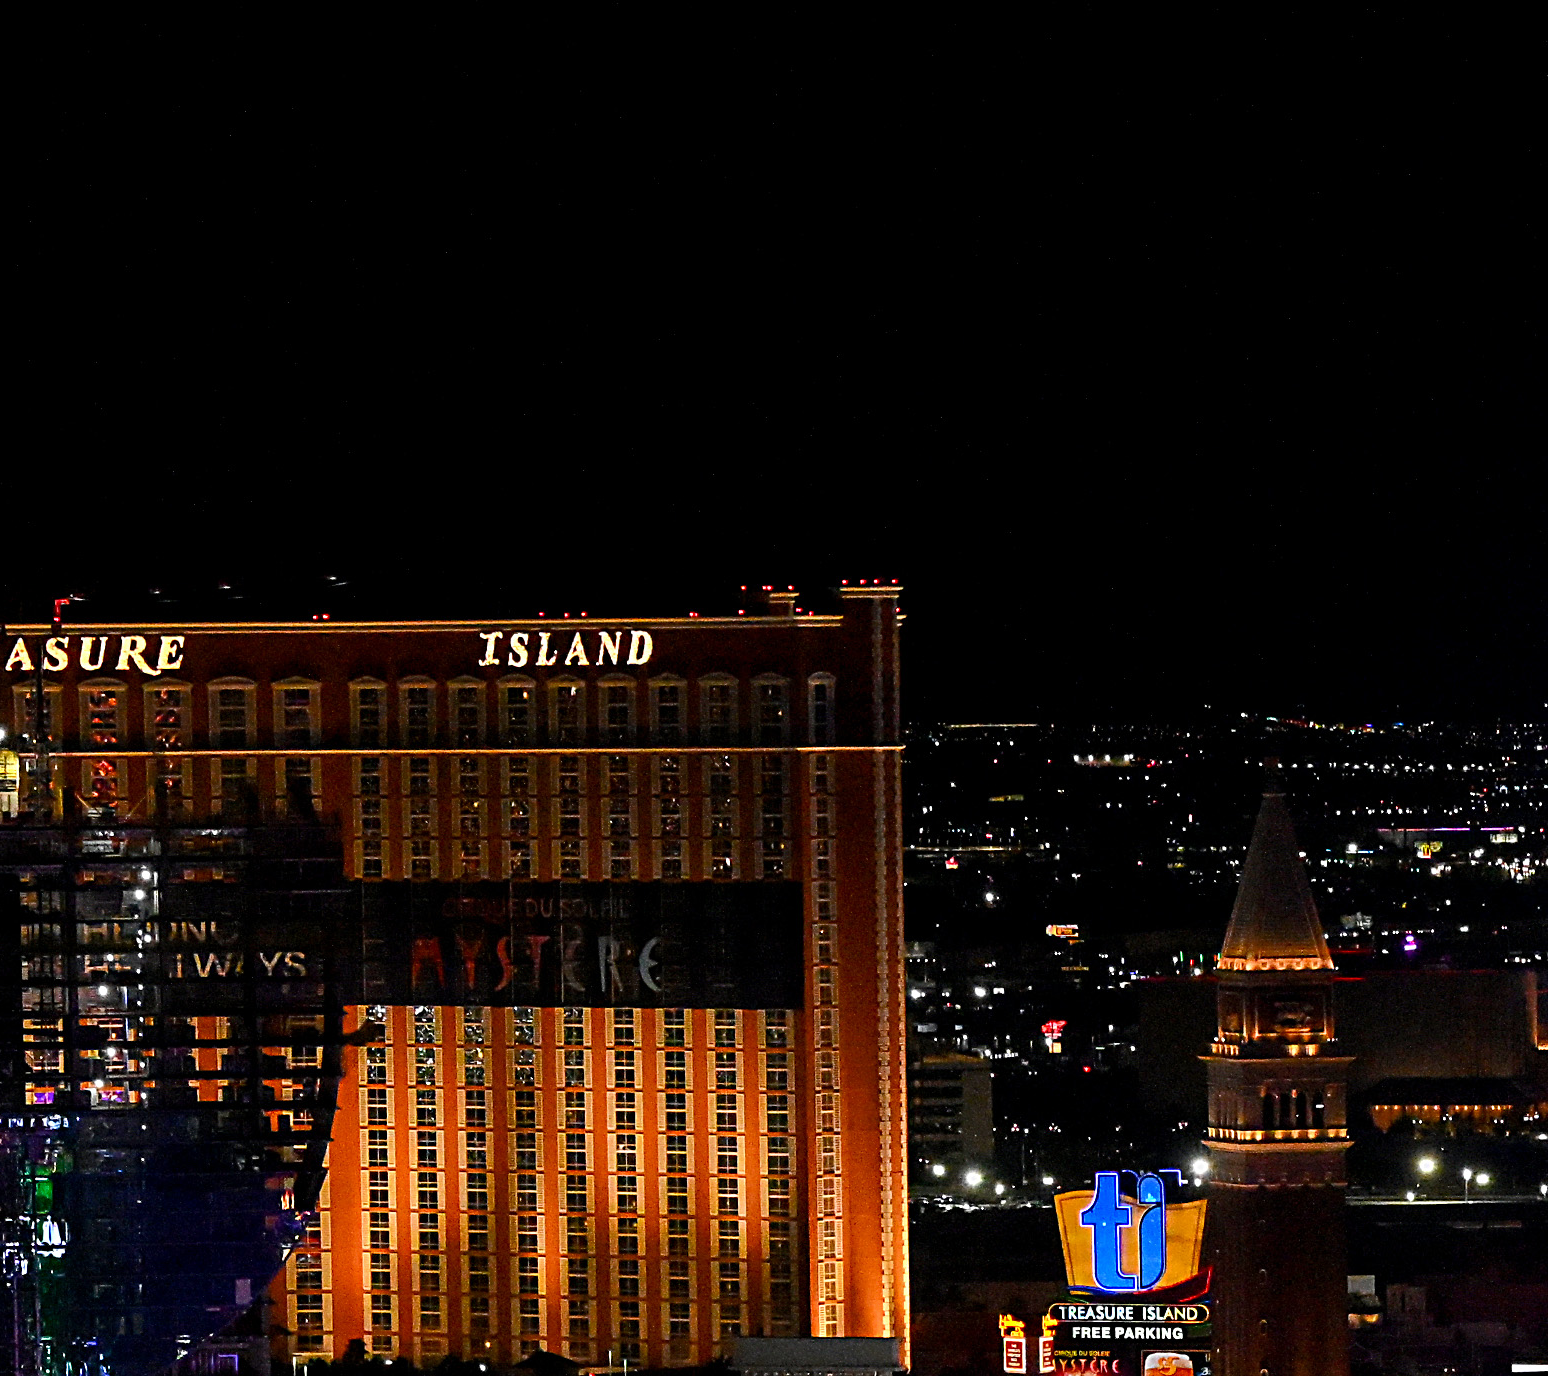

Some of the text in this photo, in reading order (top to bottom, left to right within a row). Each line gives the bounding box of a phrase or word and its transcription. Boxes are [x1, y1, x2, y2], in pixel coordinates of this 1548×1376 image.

[478, 630, 654, 667] ISLAND
[1058, 1304, 1200, 1321] TREASURE ISLAND
[1072, 1326, 1184, 1341] FREE PARKING
[1054, 1350, 1077, 1360] CIRQUE
[1079, 1350, 1089, 1358] DU
